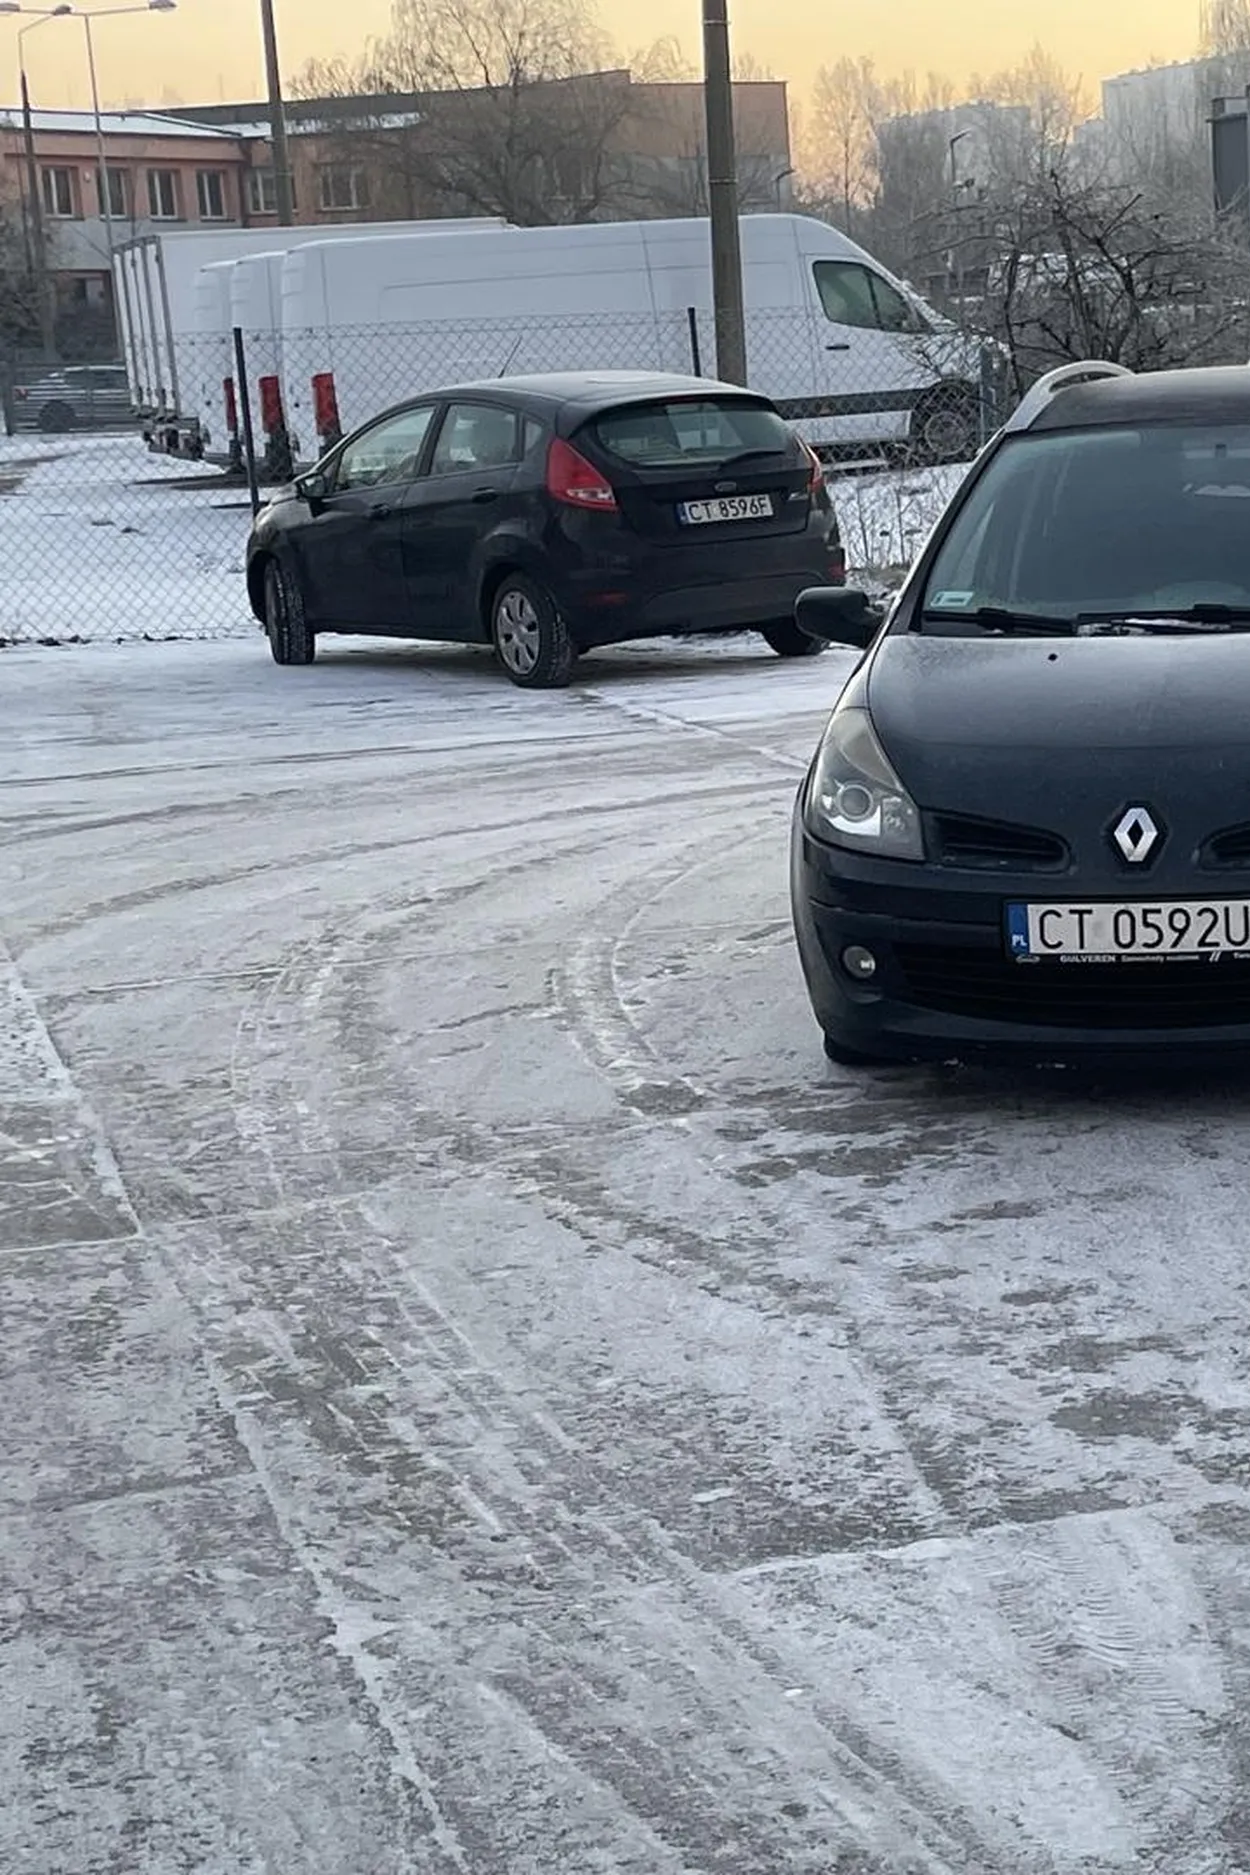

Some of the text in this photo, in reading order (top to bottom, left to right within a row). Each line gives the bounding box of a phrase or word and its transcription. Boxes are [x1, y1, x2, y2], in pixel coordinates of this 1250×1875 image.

[689, 497, 767, 520] CT 8596F
[1039, 905, 1250, 950] CT 0592U
[1012, 935, 1028, 947] PL
